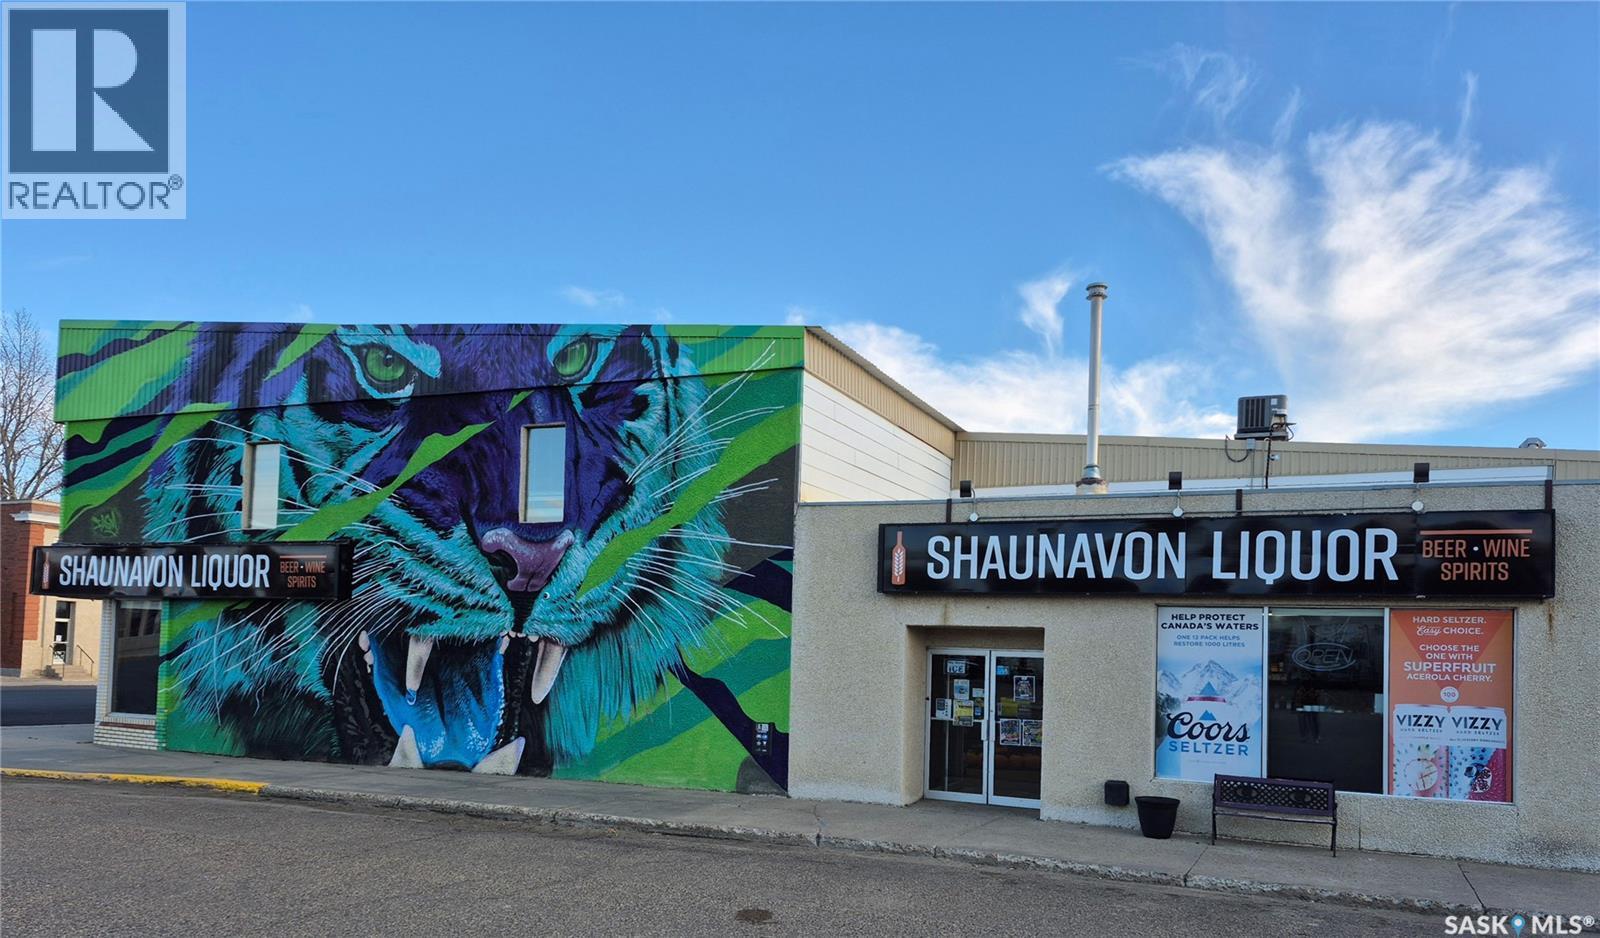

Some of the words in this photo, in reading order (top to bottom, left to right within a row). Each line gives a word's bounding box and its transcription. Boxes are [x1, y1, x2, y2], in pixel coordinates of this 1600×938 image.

[1422, 539, 1466, 559] BEER
[1483, 538, 1530, 558] WINE
[927, 531, 1187, 580] SHAUNAVON
[1212, 527, 1399, 585] LIQUOR
[59, 555, 184, 588] SHAUNAVON
[190, 554, 270, 591] LIQUOR
[279, 561, 299, 574] BEER
[305, 561, 325, 574] WINE
[1440, 562, 1509, 581] SPIRITS
[287, 576, 316, 589] SPIRITS
[1171, 613, 1197, 621] HELP
[1413, 616, 1440, 624] HARD
[1442, 616, 1487, 624] SELTZER.
[1161, 622, 1213, 630] CANADA'S
[1215, 622, 1259, 631] WATERS
[1416, 625, 1442, 636] Easy
[1443, 627, 1484, 635] CHOICE.
[1419, 644, 1459, 652] CHOOSE
[1461, 644, 1480, 652] THE
[1296, 648, 1353, 664] OPEN
[1425, 652, 1446, 660] ONE
[949, 665, 964, 673] ICE
[1403, 661, 1496, 674] SUPERFRUIT
[1406, 673, 1450, 681] ACEROLA
[1453, 674, 1493, 682] CHERRY.
[1167, 711, 1250, 742] Coors
[1396, 714, 1446, 728] VIZZY
[1451, 716, 1503, 731] VIZZY
[1169, 741, 1249, 756] SELTZER
